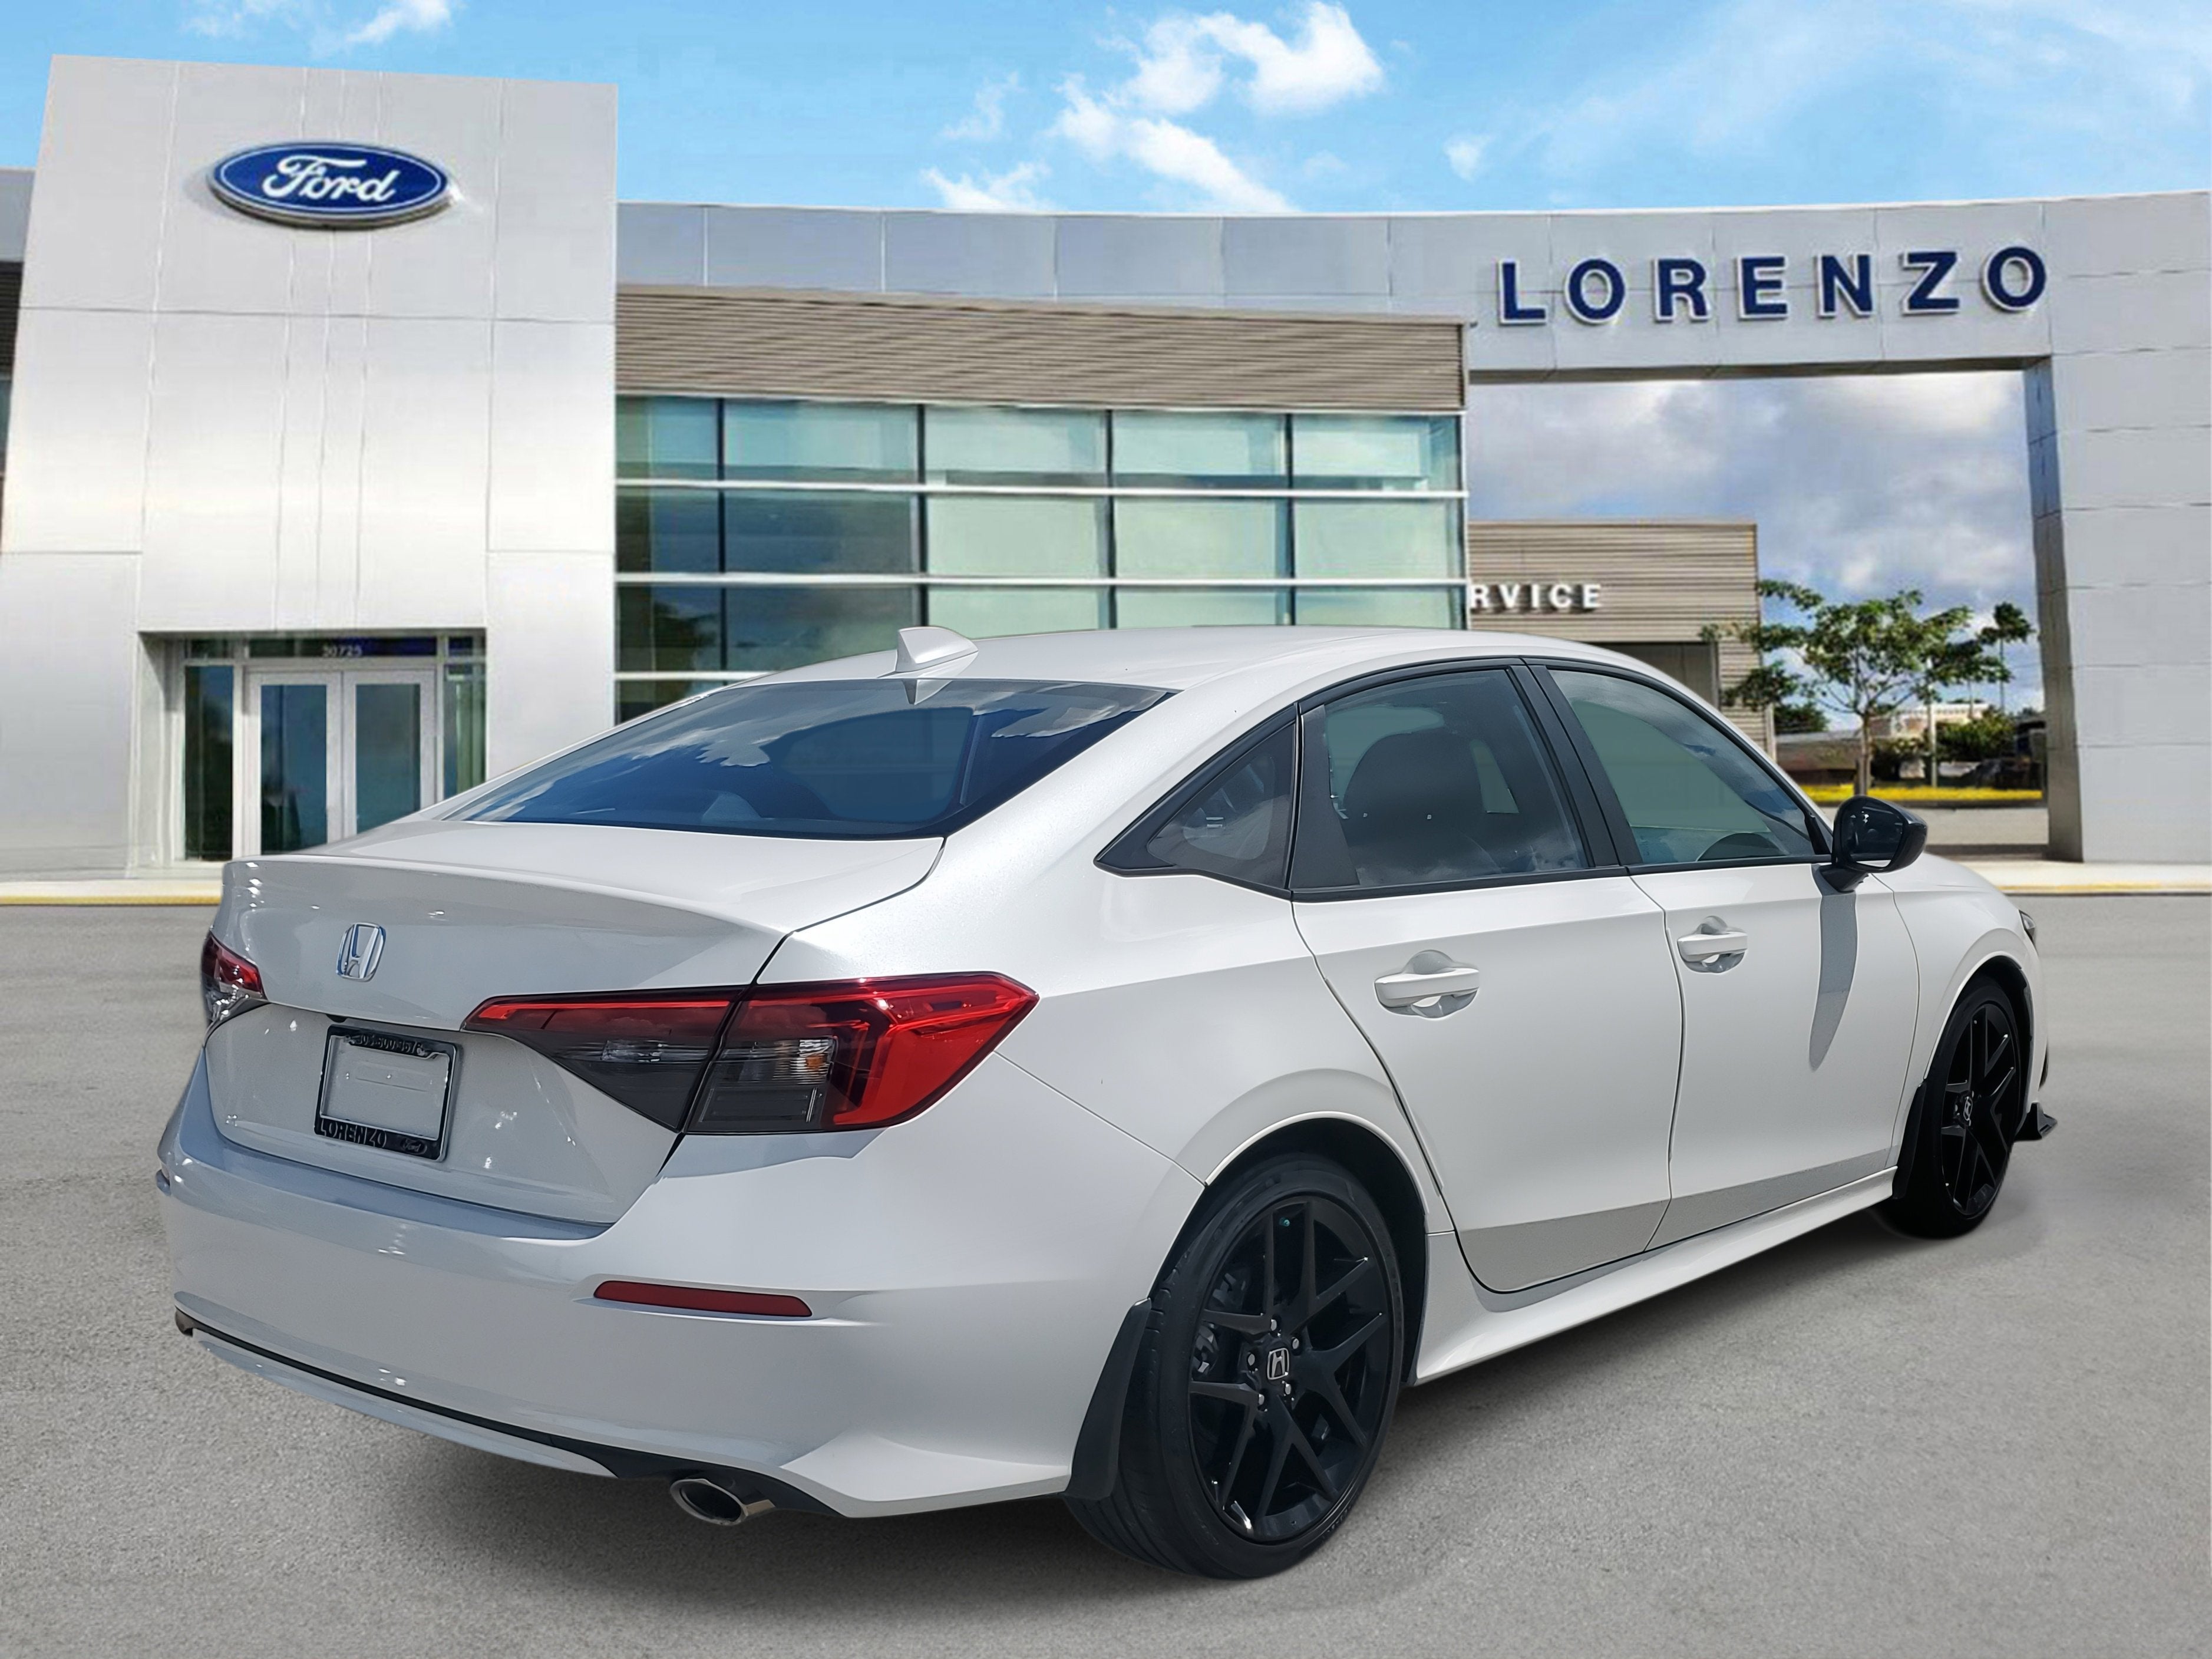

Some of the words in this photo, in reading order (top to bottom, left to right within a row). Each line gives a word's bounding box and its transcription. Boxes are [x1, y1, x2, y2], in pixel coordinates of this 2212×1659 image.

[262, 154, 401, 202] Ford
[1497, 246, 2048, 325] LORENZO
[320, 1117, 387, 1148] LORENZO
